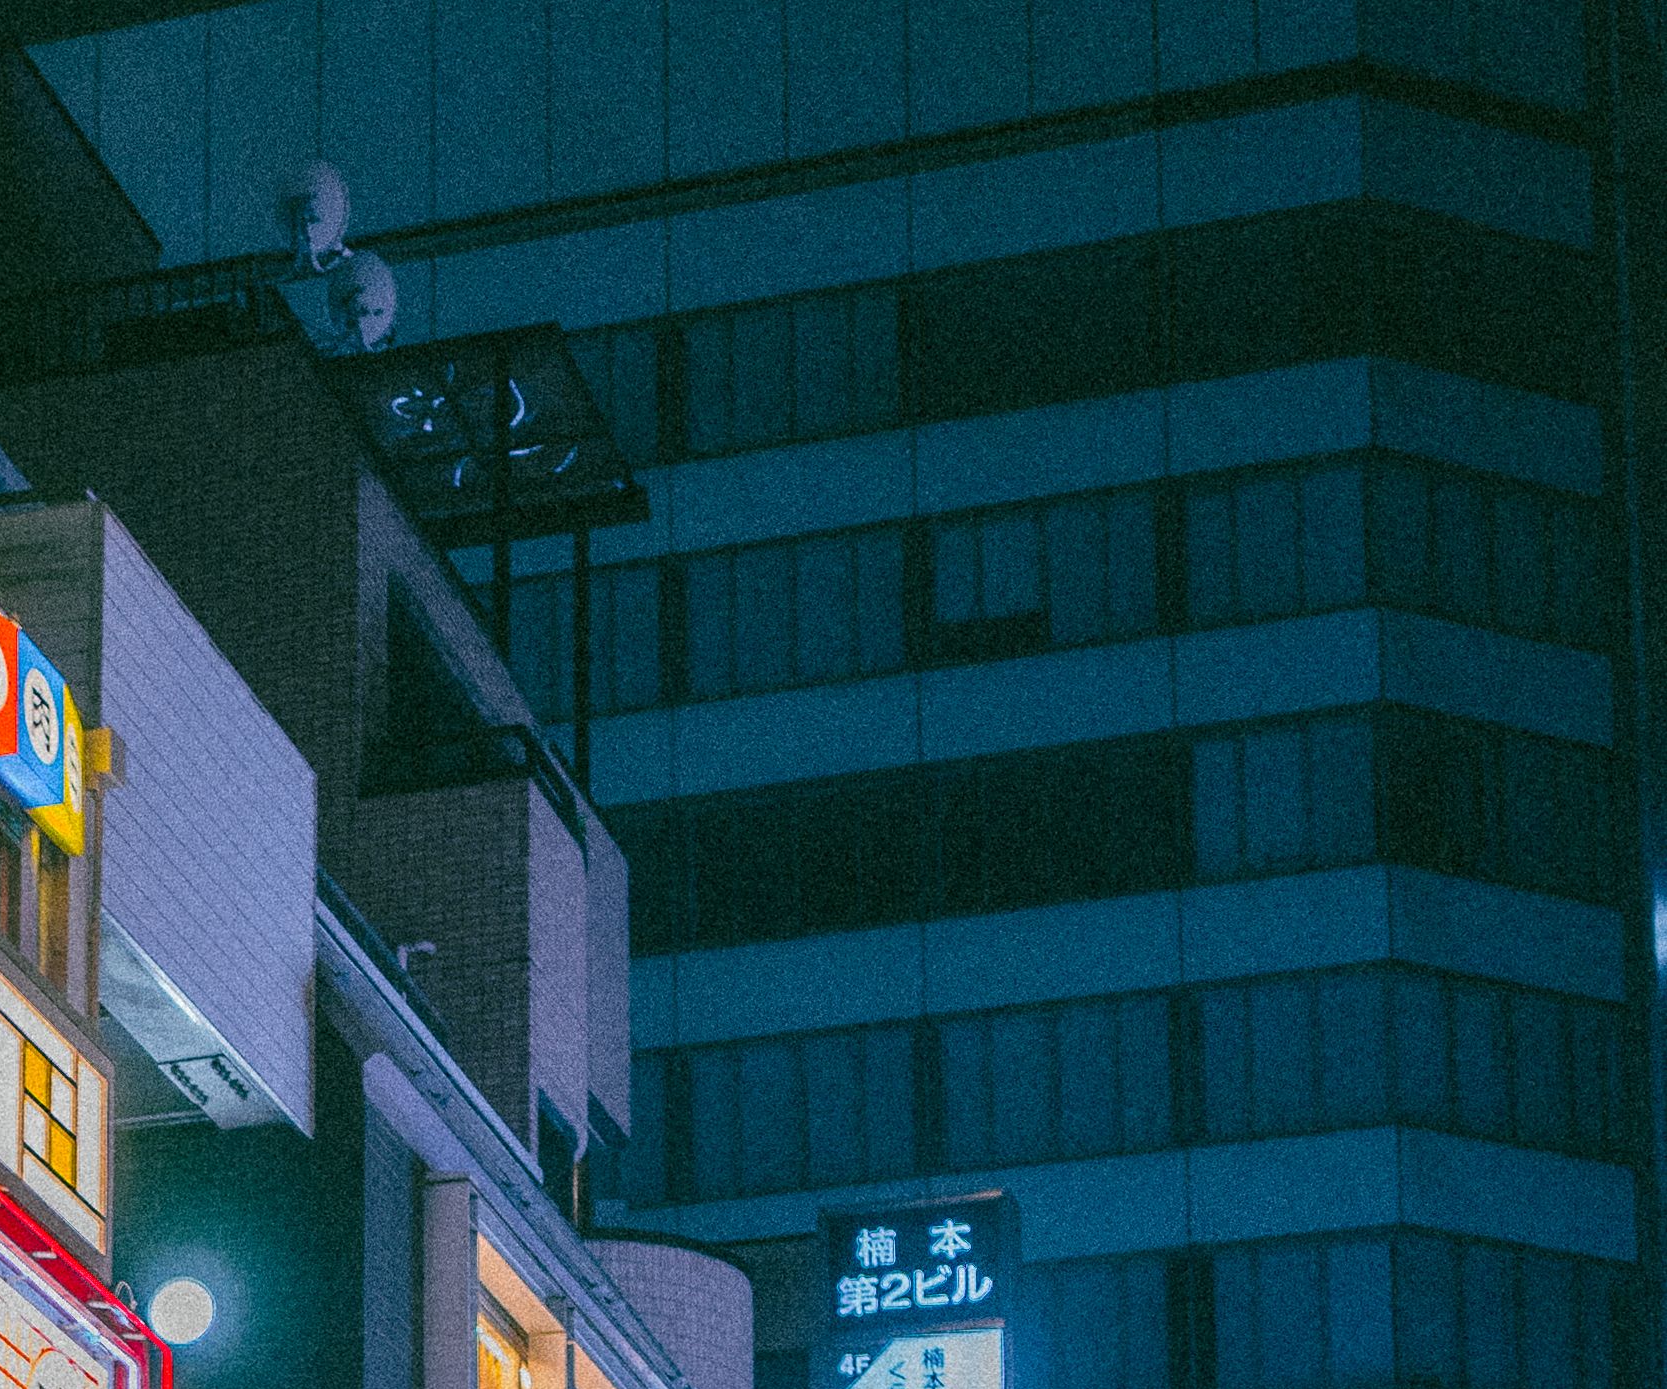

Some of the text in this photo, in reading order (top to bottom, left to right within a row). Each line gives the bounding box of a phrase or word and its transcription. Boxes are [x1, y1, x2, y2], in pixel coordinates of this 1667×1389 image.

[856, 1218, 972, 1268] 楠本
[837, 1263, 993, 1316] 第2ビル
[838, 1353, 870, 1376] 4F
